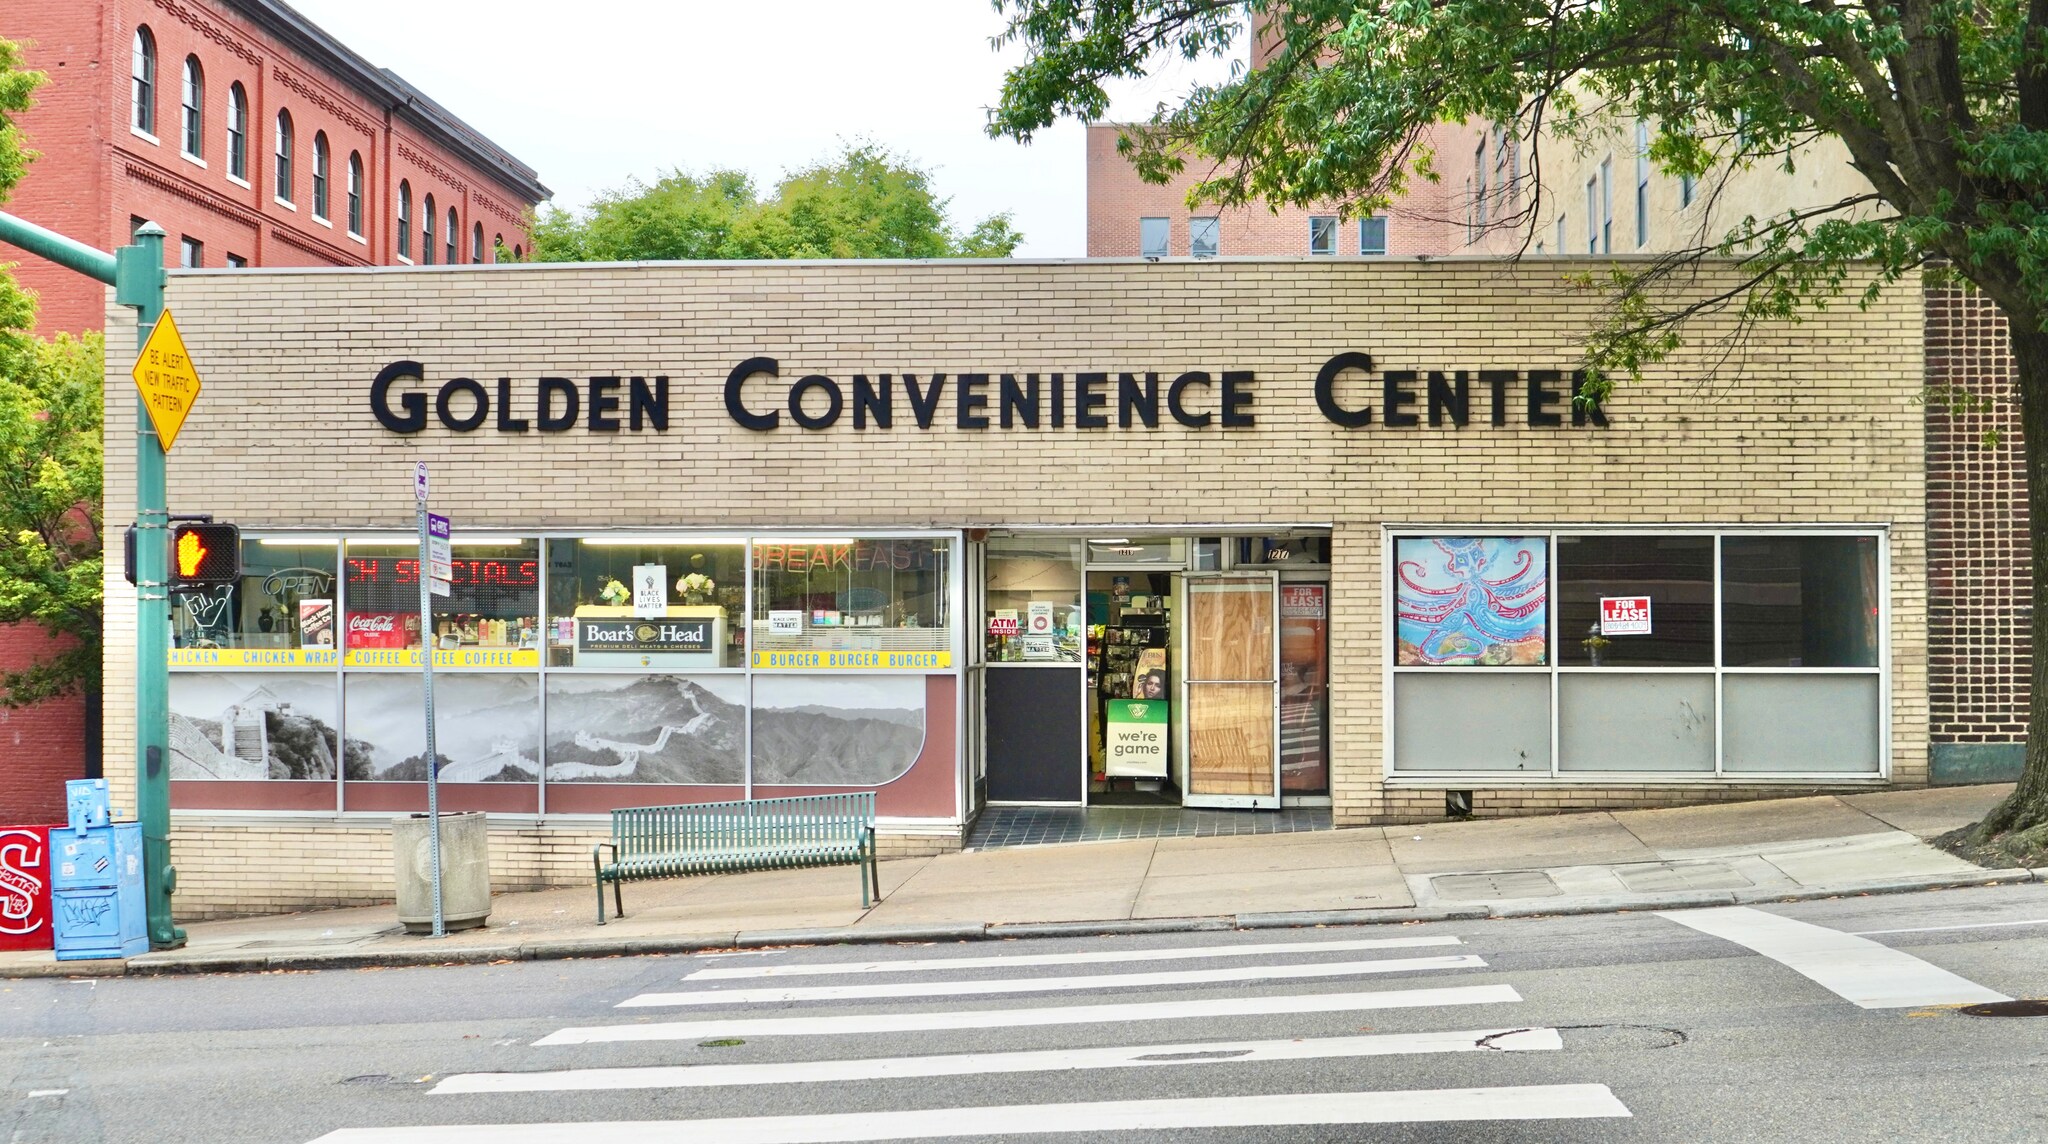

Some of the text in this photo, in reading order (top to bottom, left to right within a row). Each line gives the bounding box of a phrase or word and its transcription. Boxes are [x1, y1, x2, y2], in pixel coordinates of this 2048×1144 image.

[150, 349, 184, 371] BE ALERT
[144, 370, 190, 393] NEW TRAFFIC
[370, 359, 669, 433] GOLDEN
[724, 356, 1256, 431] CONVENIENCE
[152, 393, 183, 412] PATTERN
[1268, 549, 1290, 560] 1217
[396, 560, 537, 584] SPCIALS
[264, 576, 332, 595] OPEN
[1293, 587, 1312, 596] FOR
[1283, 596, 1323, 607] LEASE
[1615, 600, 1636, 609] FOR
[1604, 608, 1648, 621] LEASE
[349, 615, 395, 633] Coca-Cola
[991, 618, 1017, 628] ATM
[587, 625, 704, 643] Boar's Head
[168, 651, 337, 664] HICKEN CHICKEN WRAP
[355, 652, 513, 665] COFFEE COFEE COFFEE
[770, 653, 819, 666] BURGER
[830, 653, 879, 666] BURGER
[889, 654, 938, 667] BURGER
[1118, 730, 1158, 742] we're
[1114, 744, 1160, 757] game
